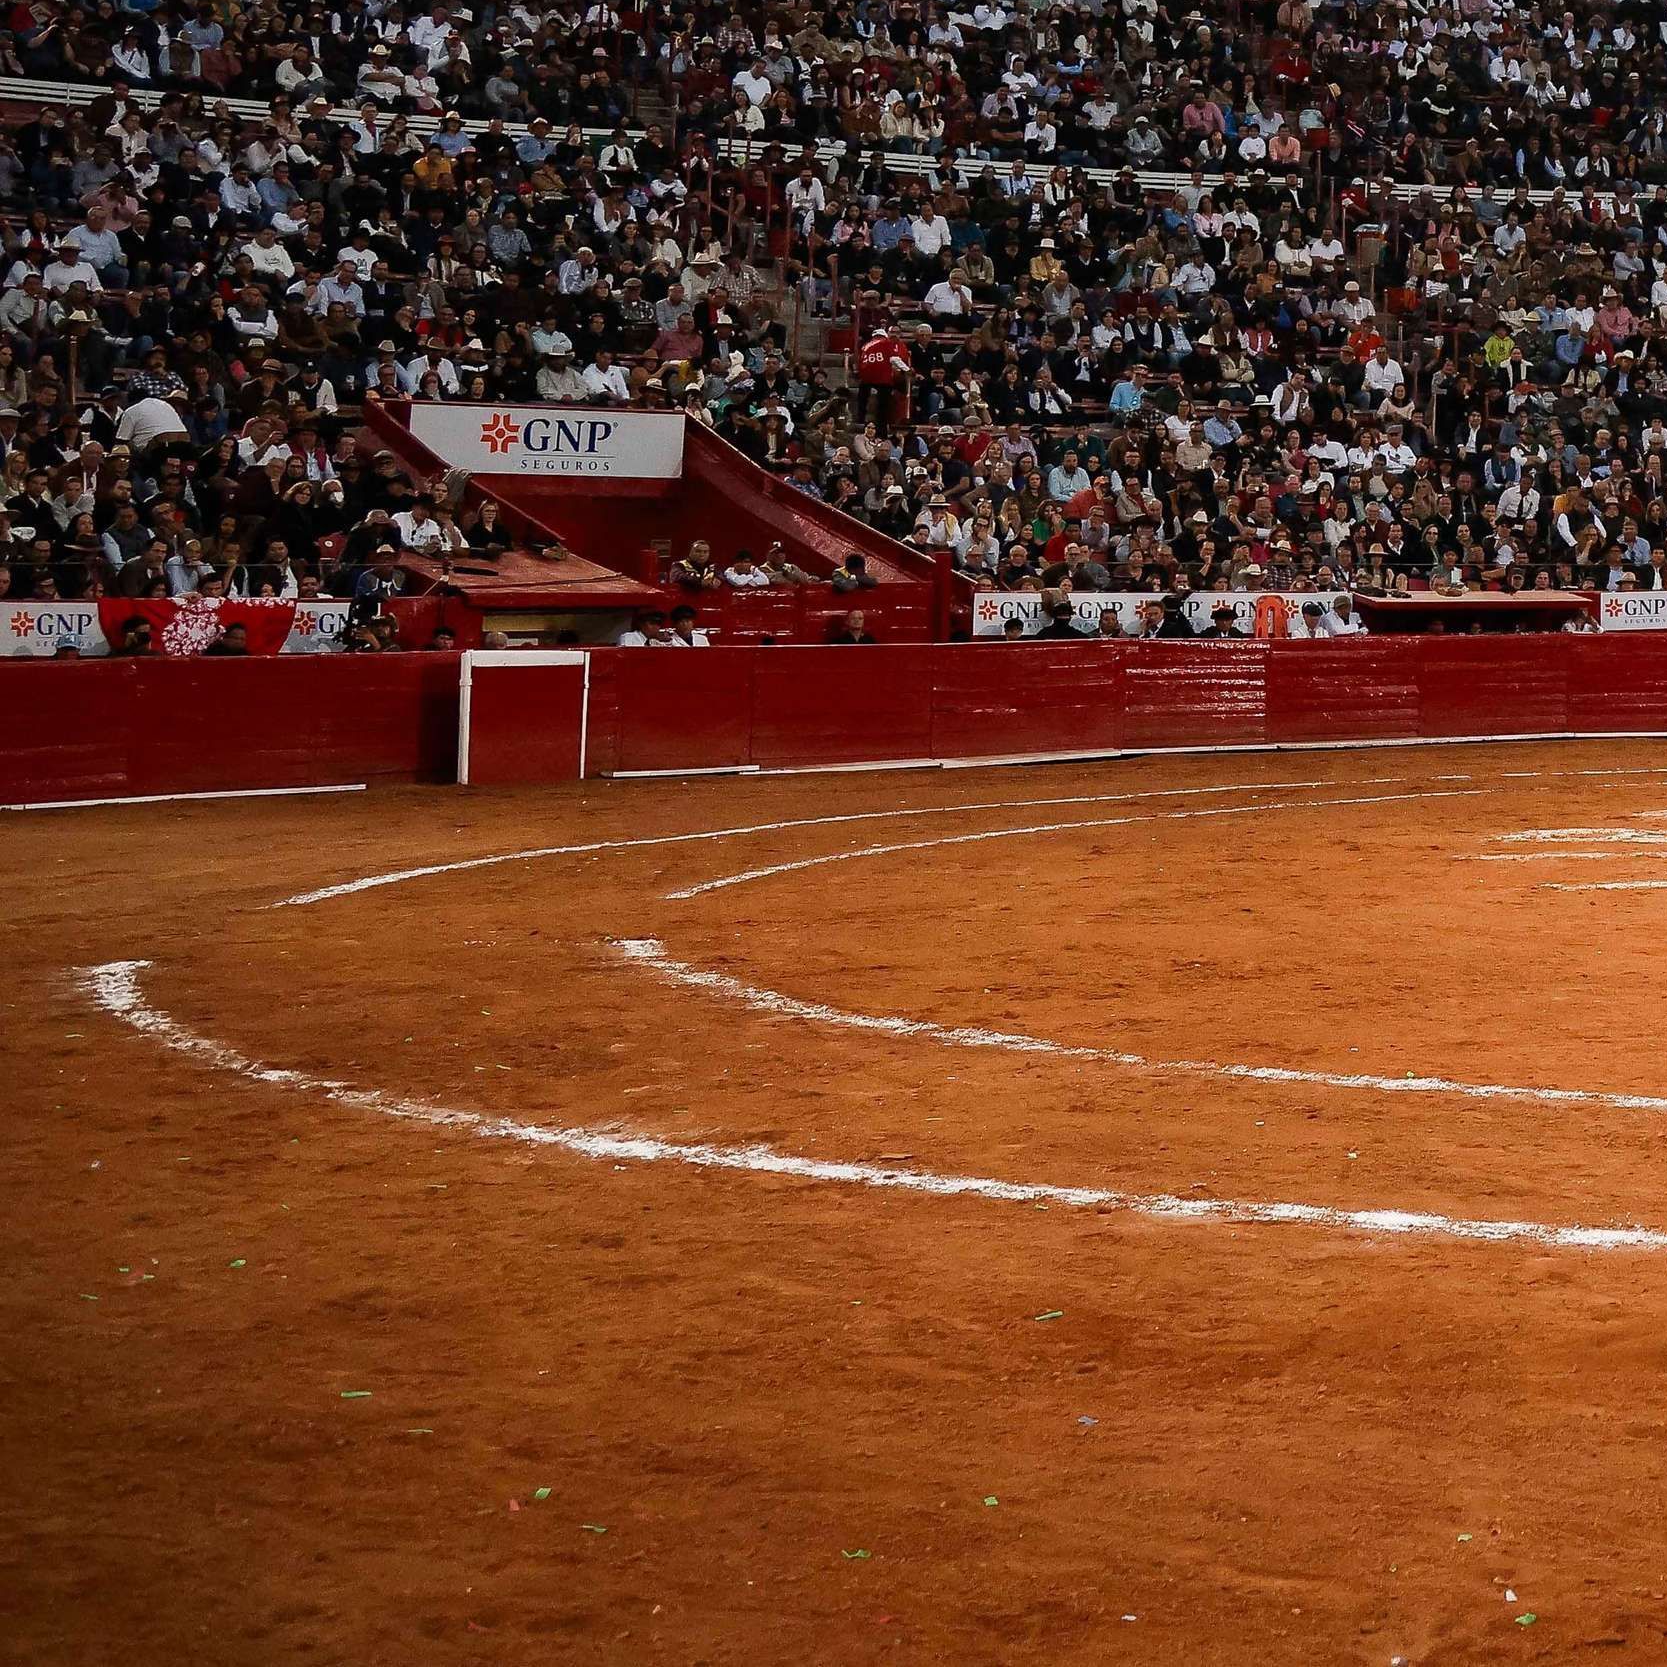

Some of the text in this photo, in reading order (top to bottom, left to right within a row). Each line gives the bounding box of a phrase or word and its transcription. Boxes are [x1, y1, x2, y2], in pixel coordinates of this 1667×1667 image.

[522, 418, 613, 453] GNP
[520, 458, 612, 472] SEGUROS
[999, 601, 1044, 620] GNP
[1078, 601, 1123, 620] GNP
[1624, 598, 1666, 616] GNP
[36, 613, 93, 636] GNP
